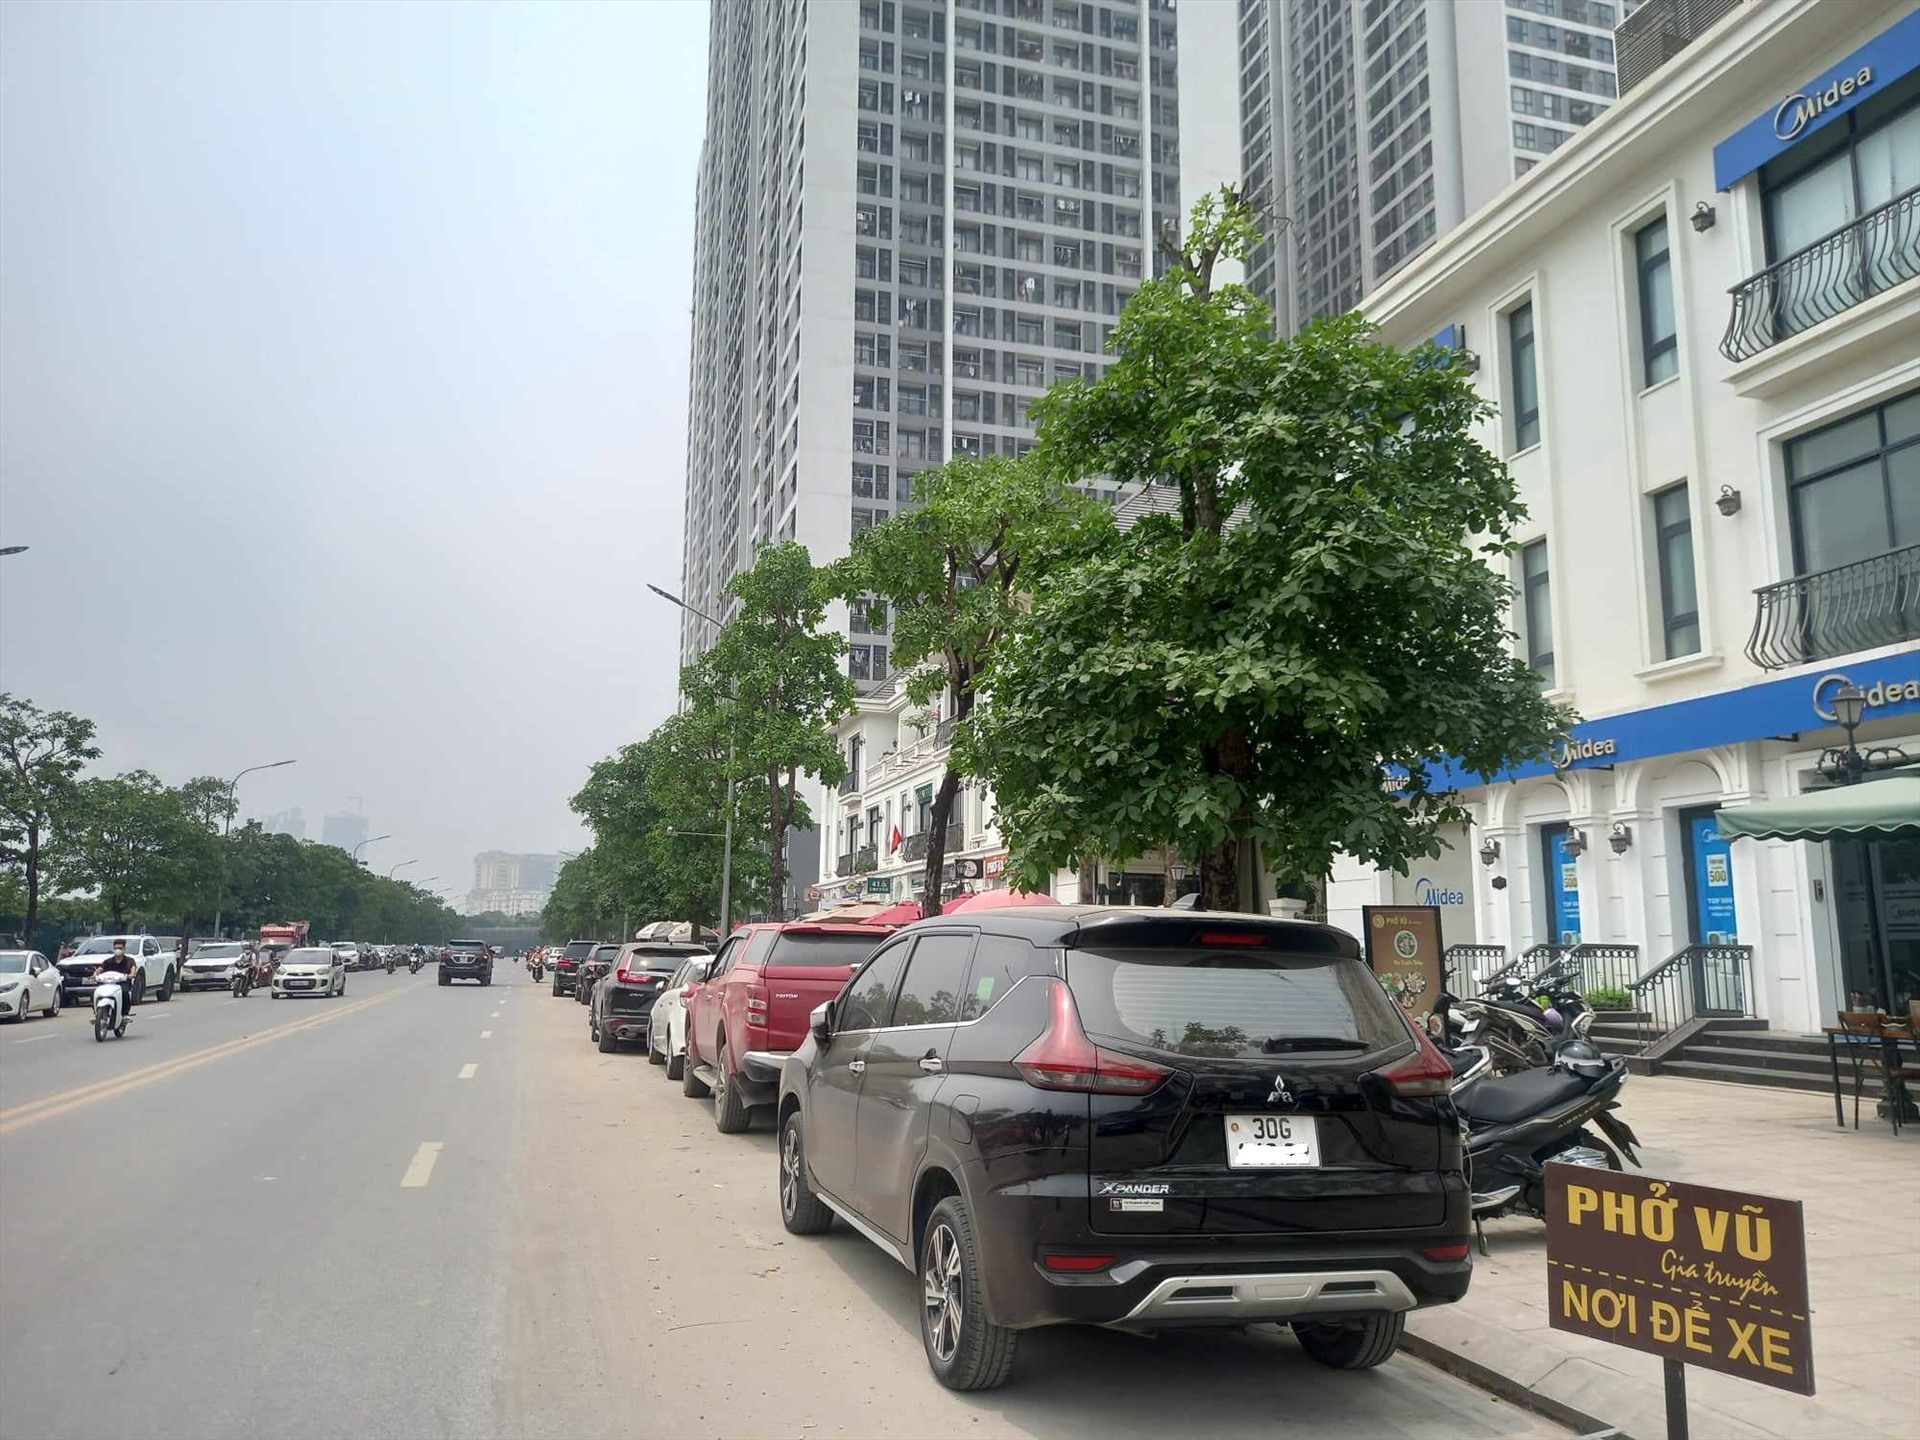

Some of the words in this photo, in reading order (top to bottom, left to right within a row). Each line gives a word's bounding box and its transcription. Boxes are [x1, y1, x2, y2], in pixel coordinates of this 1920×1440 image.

[1774, 66, 1872, 140] Midea
[1813, 674, 1920, 721] idea
[1550, 732, 1616, 768] Midea
[1415, 878, 1464, 906] Midea
[1252, 1117, 1292, 1140] 30G
[1098, 1182, 1170, 1194] XPANDER
[1566, 1182, 1679, 1242] PHỞ
[1693, 1204, 1773, 1262] VŨ
[1661, 1249, 1699, 1281] Gia
[1704, 1261, 1778, 1300] truyền
[1562, 1280, 1637, 1334] NƠI
[1649, 1300, 1713, 1354] ĐỂ
[1726, 1318, 1794, 1375] XE
